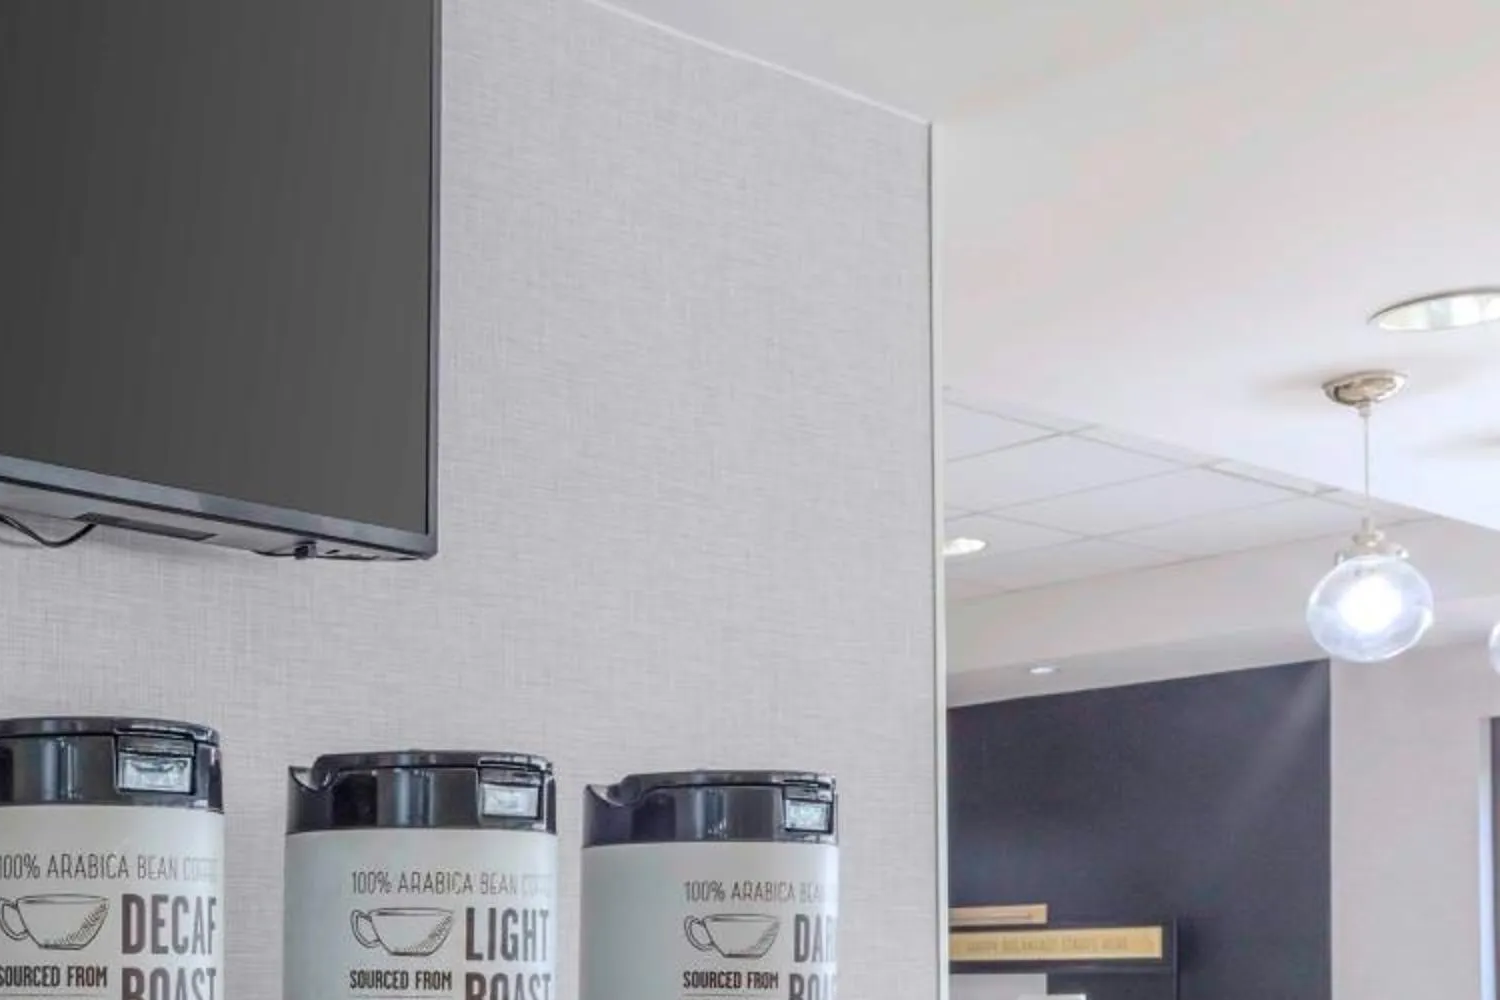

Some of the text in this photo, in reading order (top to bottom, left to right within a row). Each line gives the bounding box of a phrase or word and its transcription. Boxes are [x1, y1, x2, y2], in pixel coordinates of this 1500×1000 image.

[47, 854, 129, 880] ARABICA
[137, 854, 177, 881] BEAN
[352, 871, 392, 895] 100%
[398, 871, 473, 895] ARABICA
[479, 872, 516, 895] BEAN
[683, 880, 726, 901] 100%
[730, 881, 795, 900] ARABICA
[121, 893, 217, 955] DECAF
[465, 907, 549, 961] LIGHT
[67, 965, 107, 988] FROM
[350, 970, 452, 990] SOURCED FROM
[683, 971, 779, 989] SOURCED FROM
